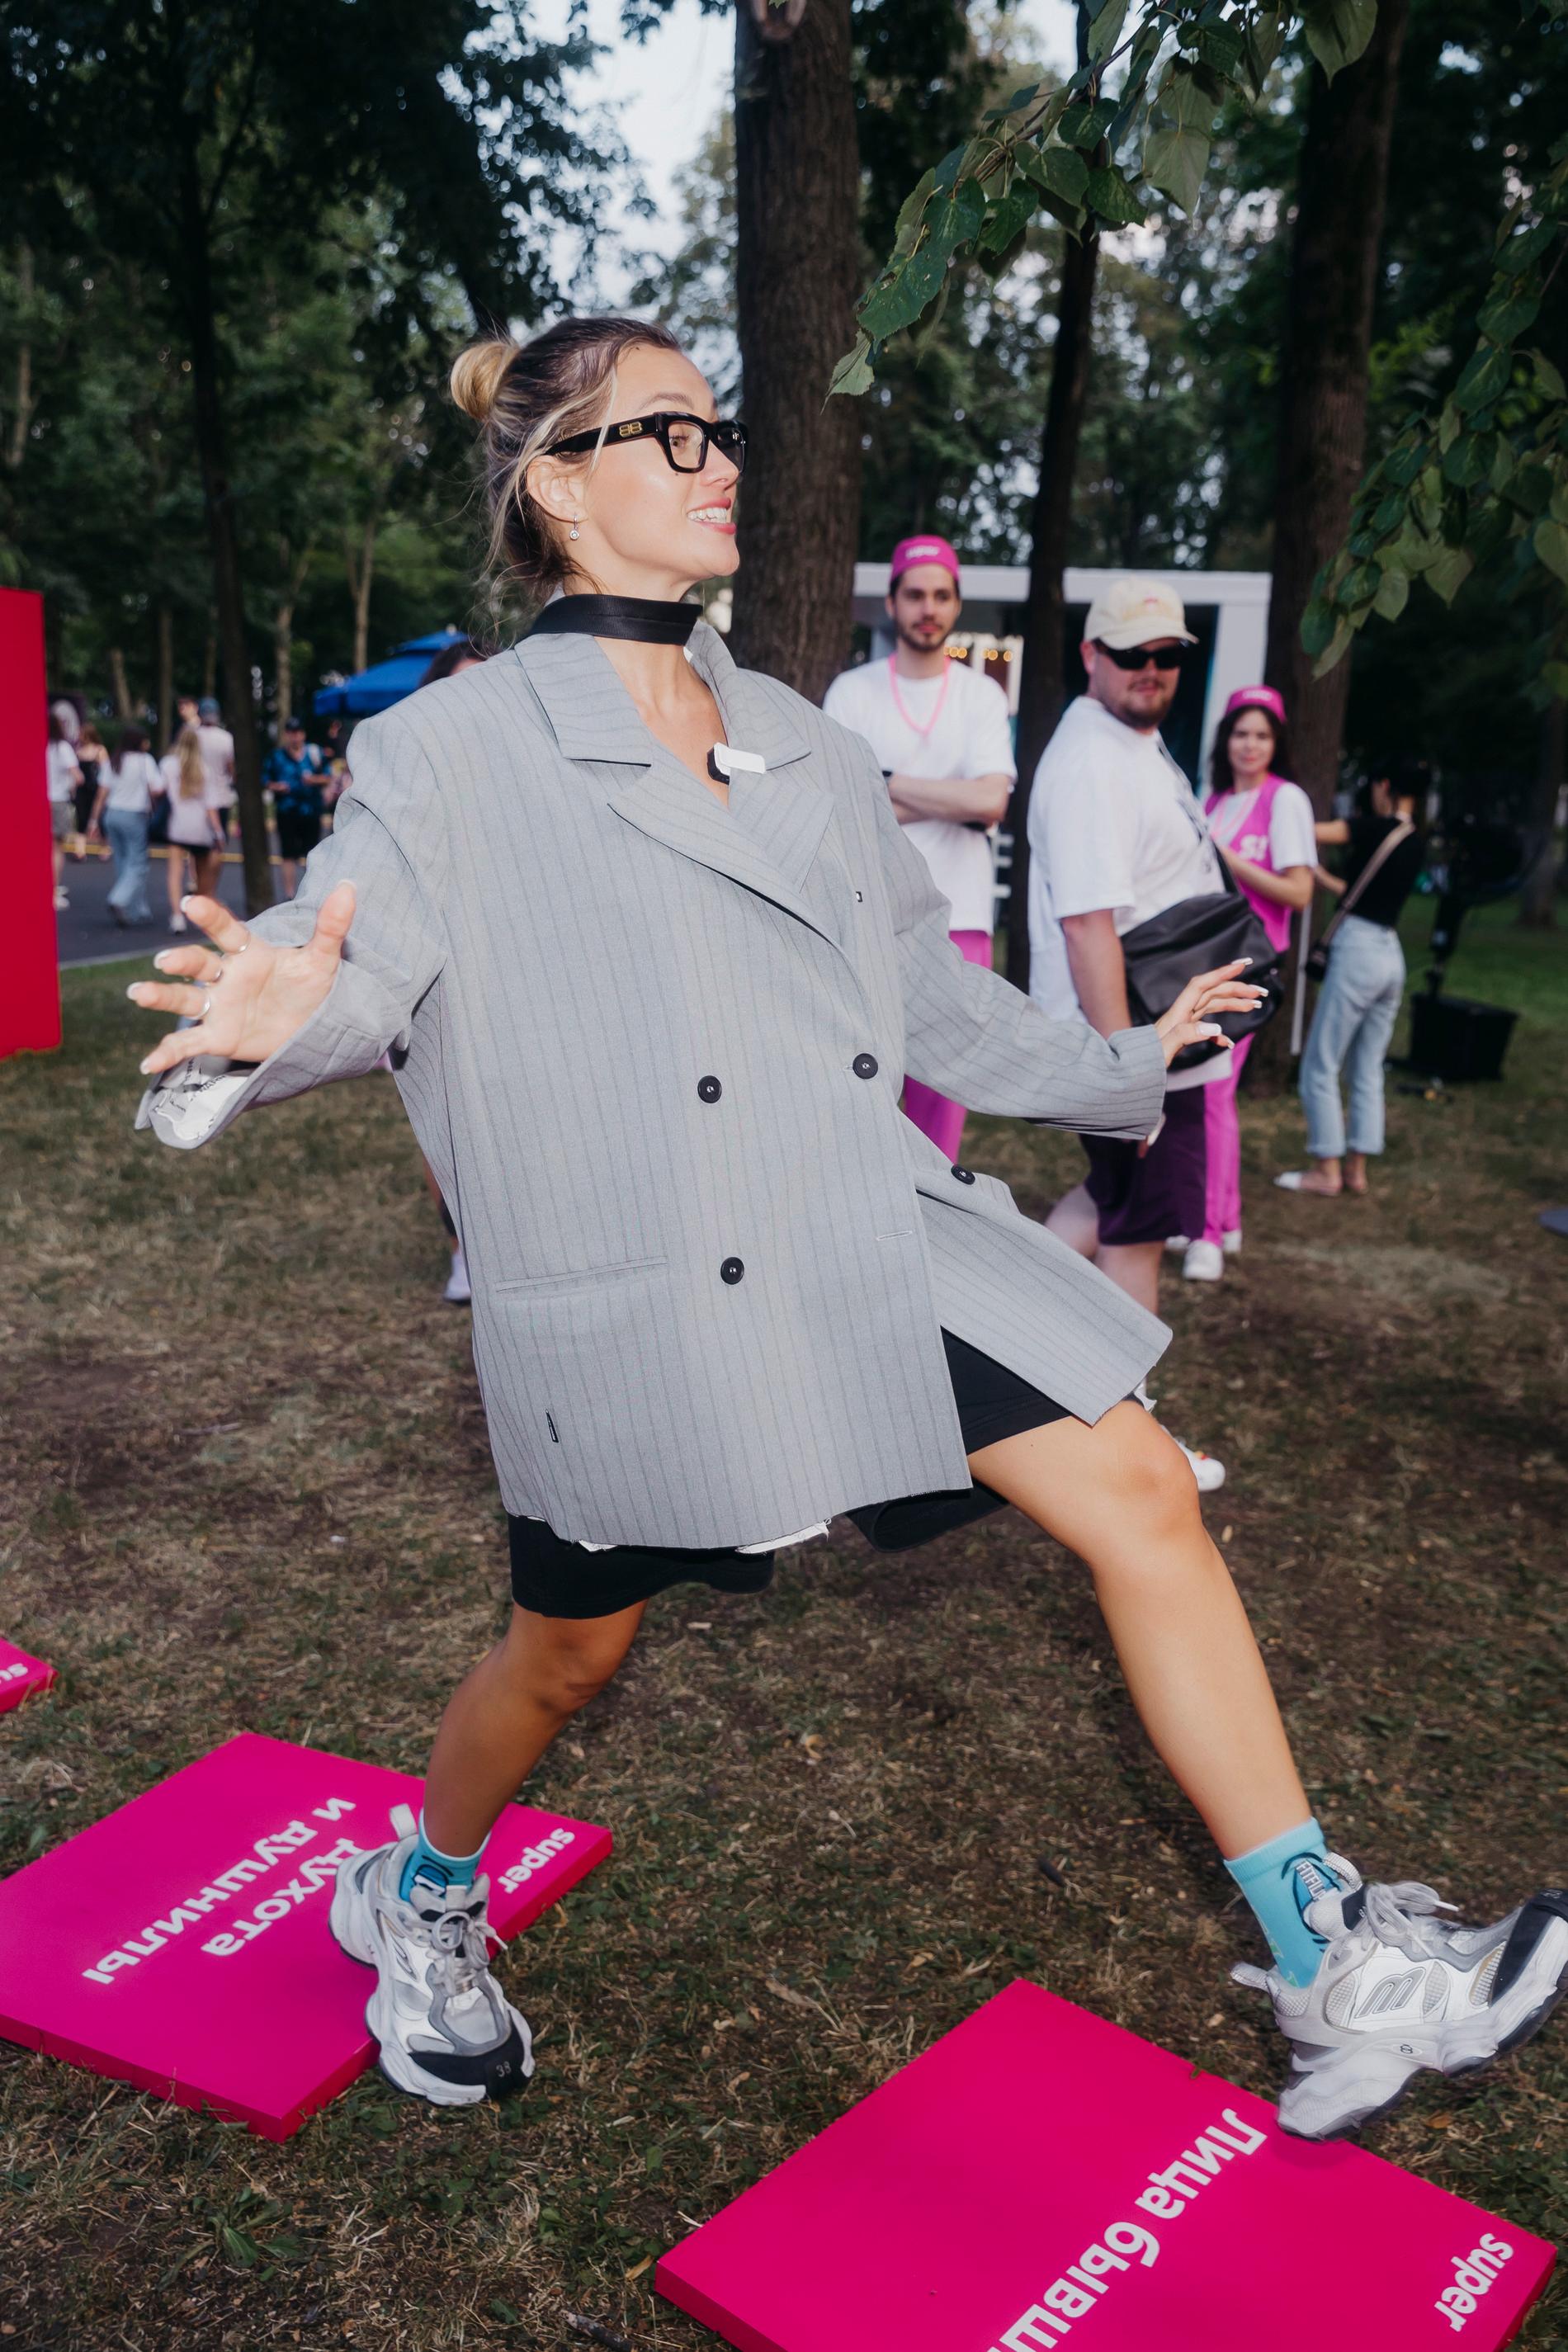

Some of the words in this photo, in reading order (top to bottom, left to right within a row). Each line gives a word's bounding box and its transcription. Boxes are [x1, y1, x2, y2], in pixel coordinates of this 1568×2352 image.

[312, 1797, 356, 1821] и
[498, 1828, 575, 1893] super
[82, 1820, 318, 1985] душнилы
[1135, 2108, 1268, 2219] Лица
[987, 2222, 1160, 2352] бывш
[1434, 2232, 1514, 2332] super
